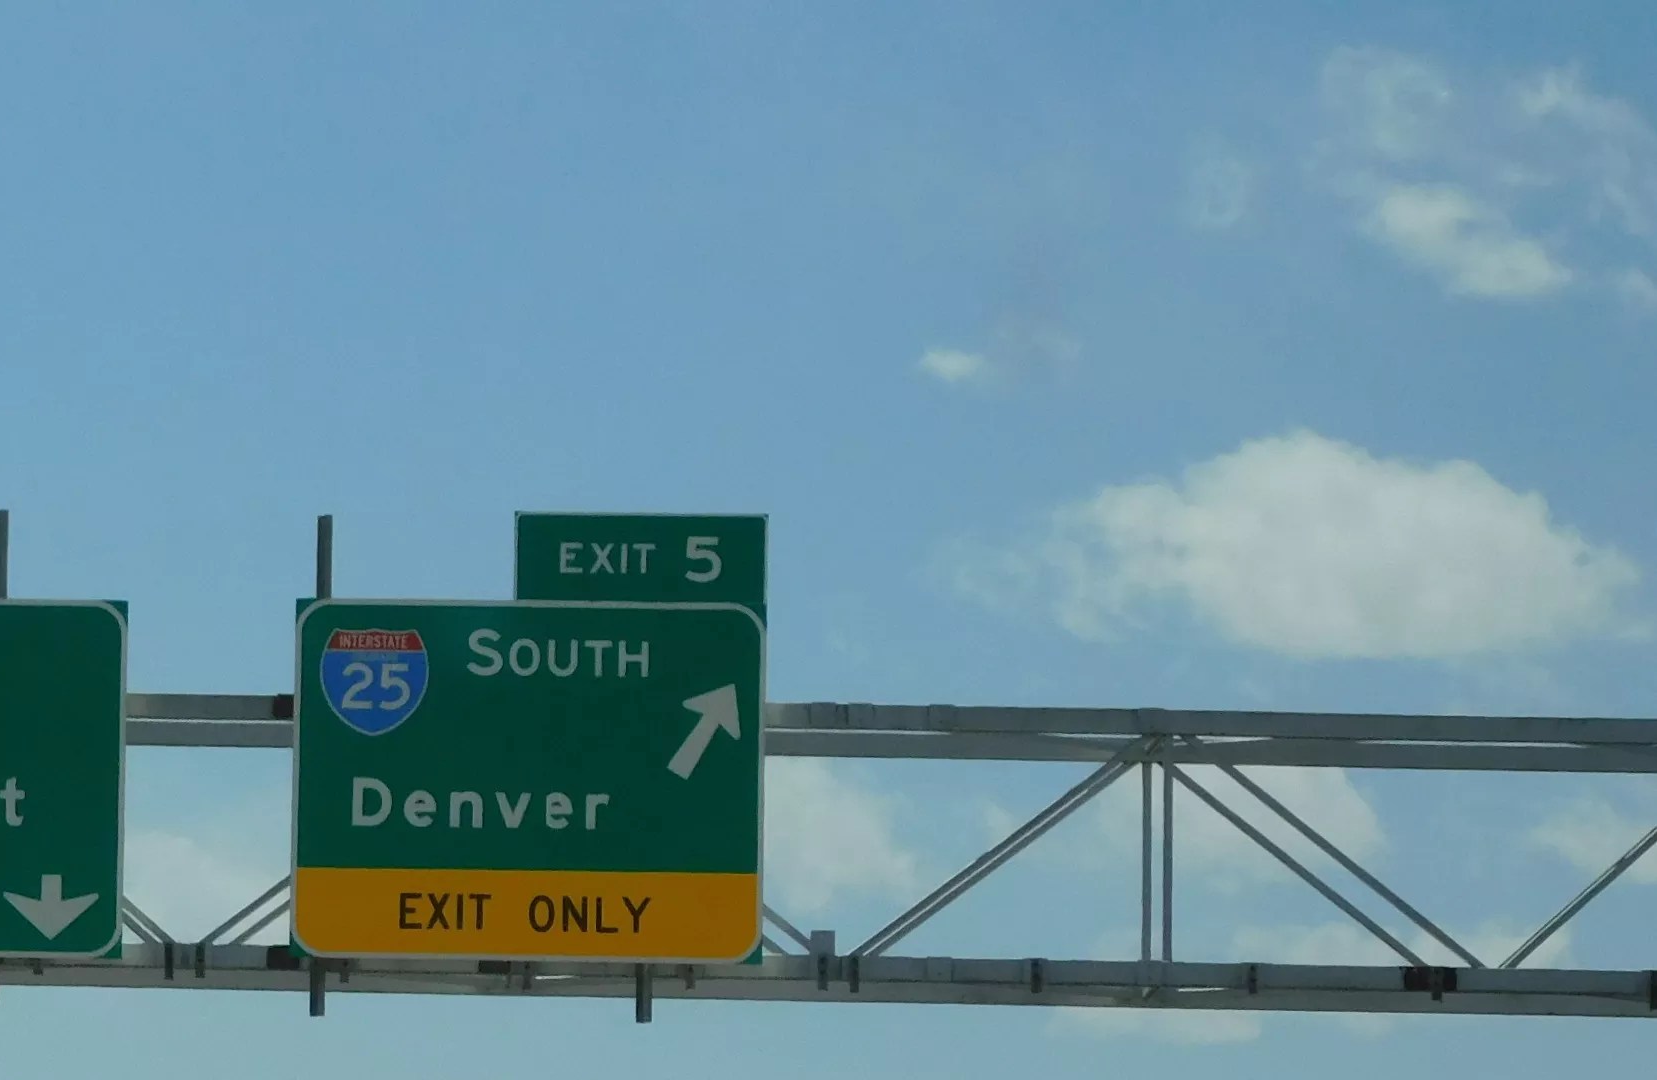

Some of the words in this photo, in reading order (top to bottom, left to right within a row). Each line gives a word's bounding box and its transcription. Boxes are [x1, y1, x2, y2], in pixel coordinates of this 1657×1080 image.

[559, 541, 656, 574] EXIT
[685, 536, 723, 583] 5
[339, 634, 408, 649] INTERSTATE
[466, 628, 650, 678] SOUTH
[341, 662, 411, 710] 25
[351, 776, 610, 831] Denver
[398, 892, 492, 930] EXIT
[528, 894, 651, 934] ONLY
